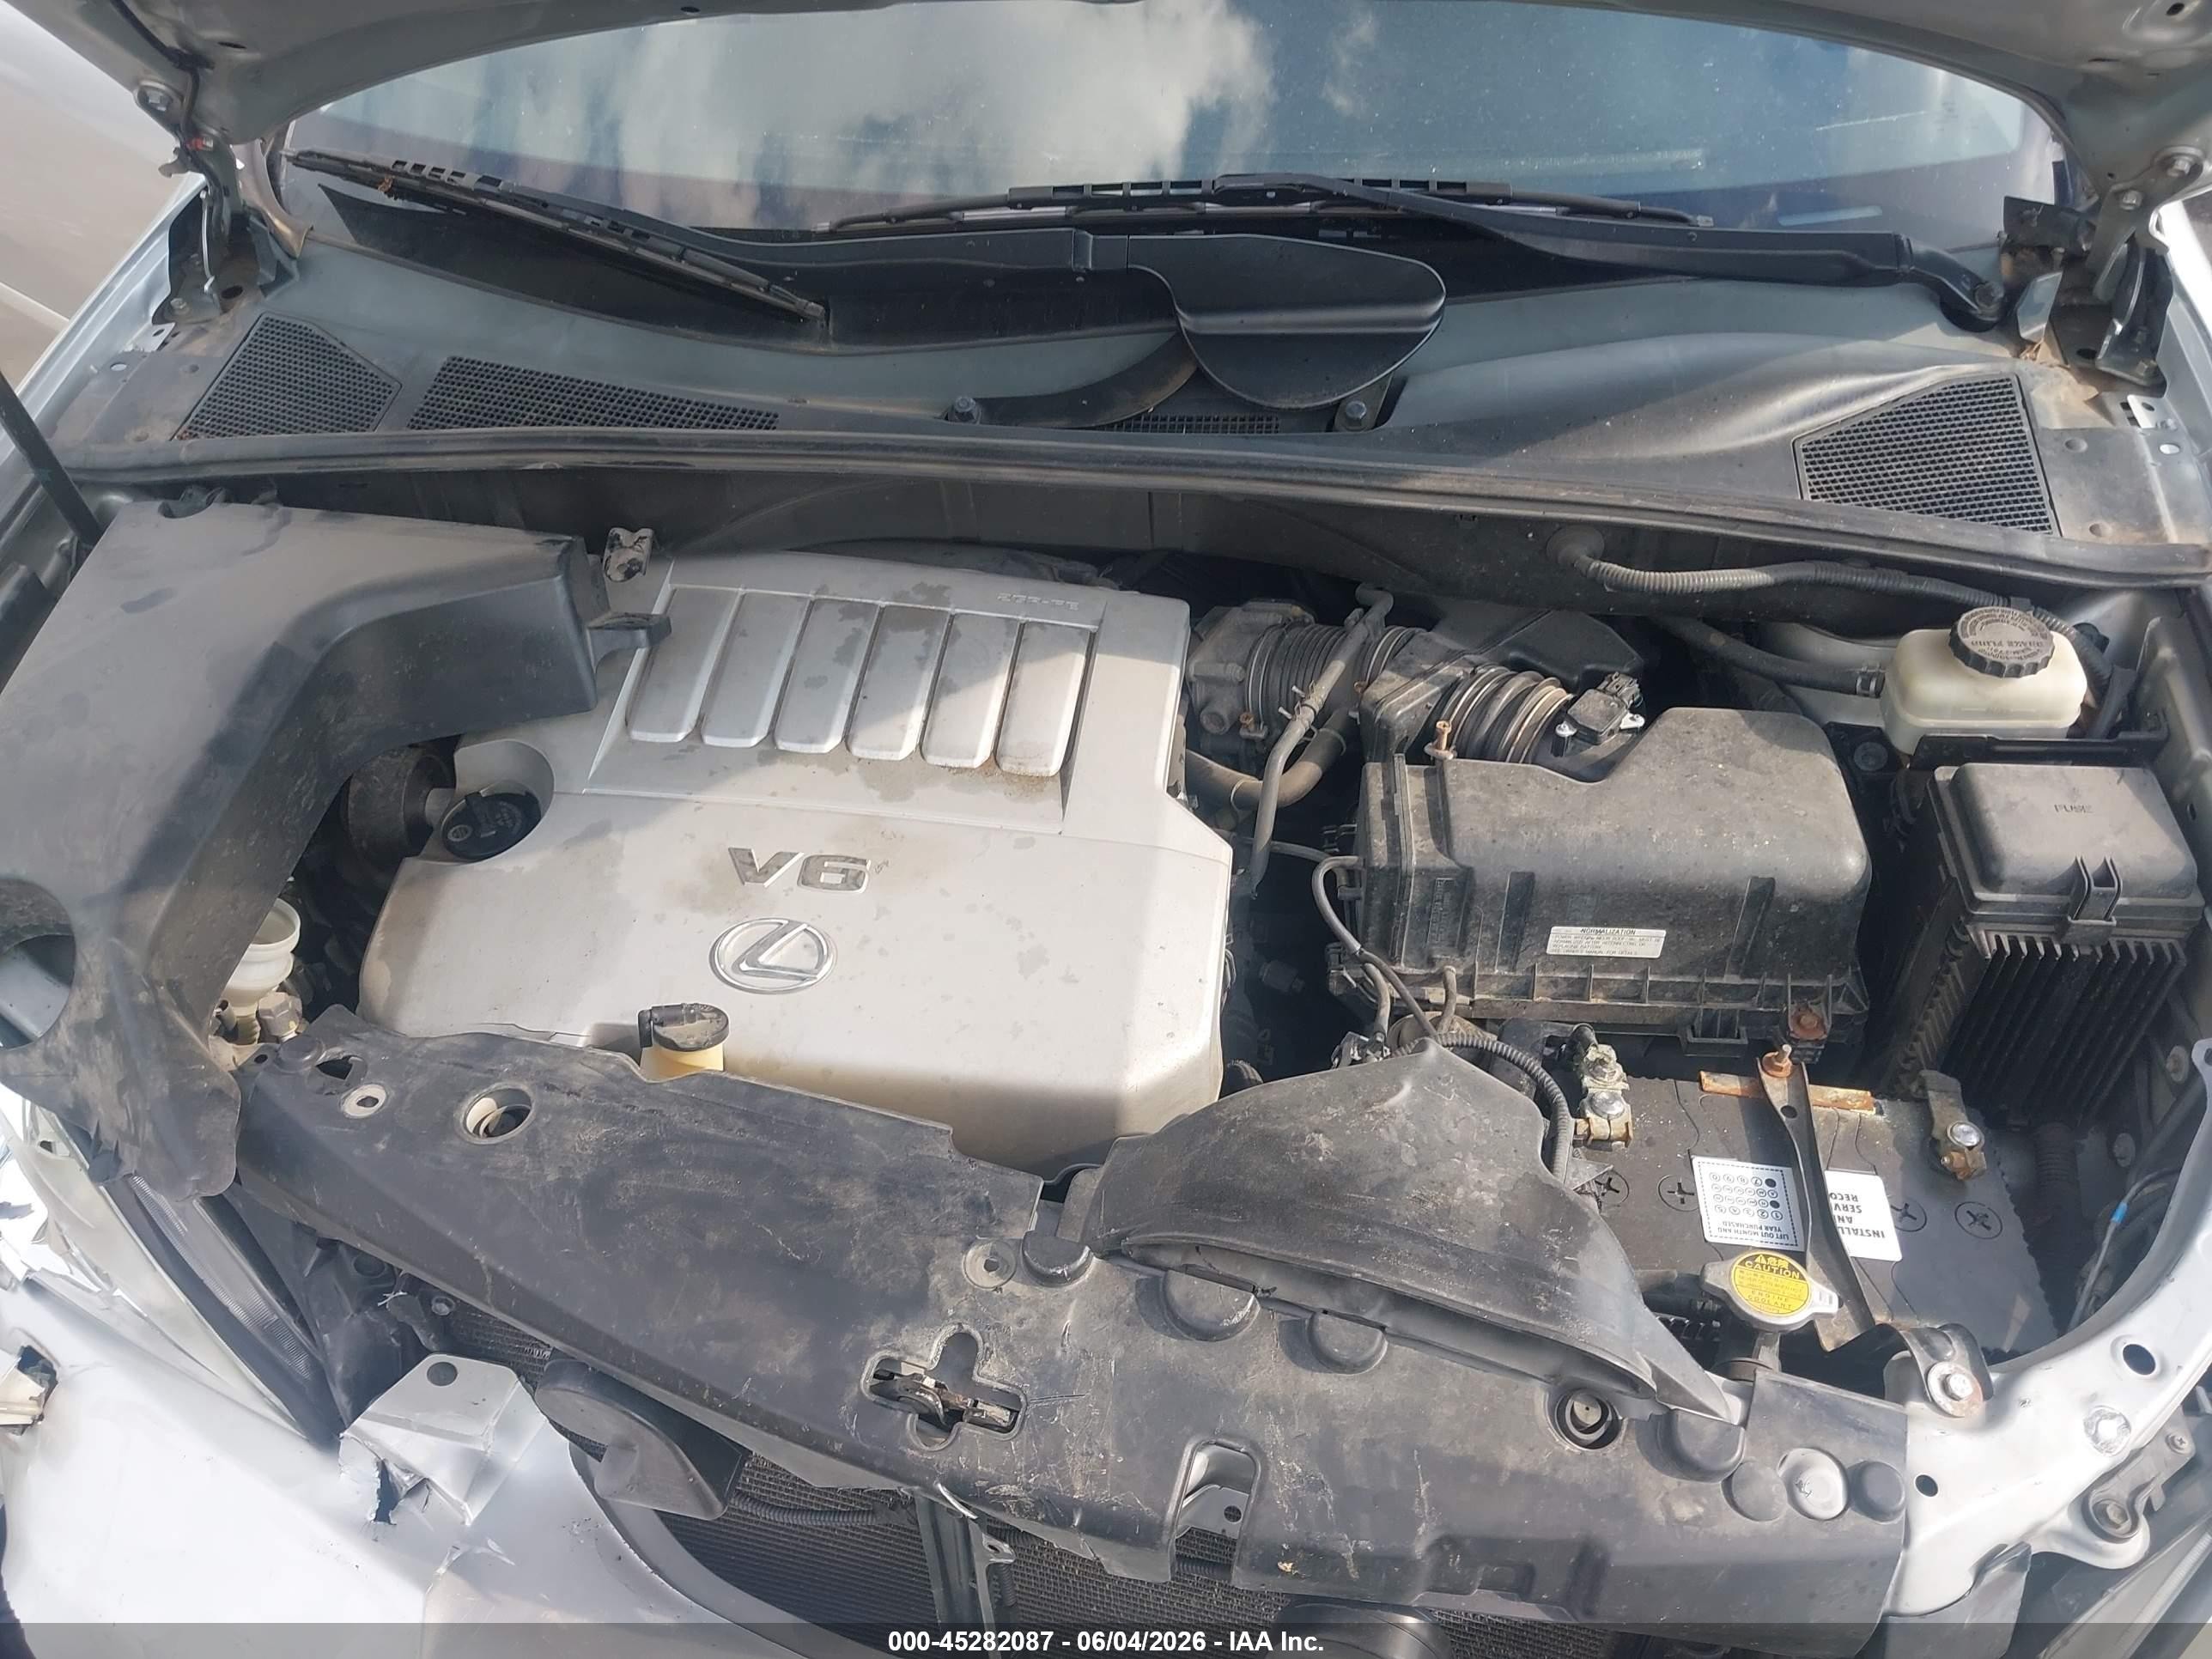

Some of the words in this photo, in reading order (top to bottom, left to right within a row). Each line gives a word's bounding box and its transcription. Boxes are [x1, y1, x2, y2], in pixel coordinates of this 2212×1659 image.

[728, 847, 872, 894] V6
[1828, 1192, 1859, 1202] RECO
[1834, 1202, 1863, 1214] SERV
[1723, 1221, 1763, 1231] PURCHASED
[1764, 1224, 1782, 1233] YEAR
[1837, 1226, 1885, 1238] INSTALL
[1775, 1232, 1790, 1241] LIFT
[1744, 1260, 1801, 1279] CAUTION
[1747, 1294, 1792, 1309] COOLANT
